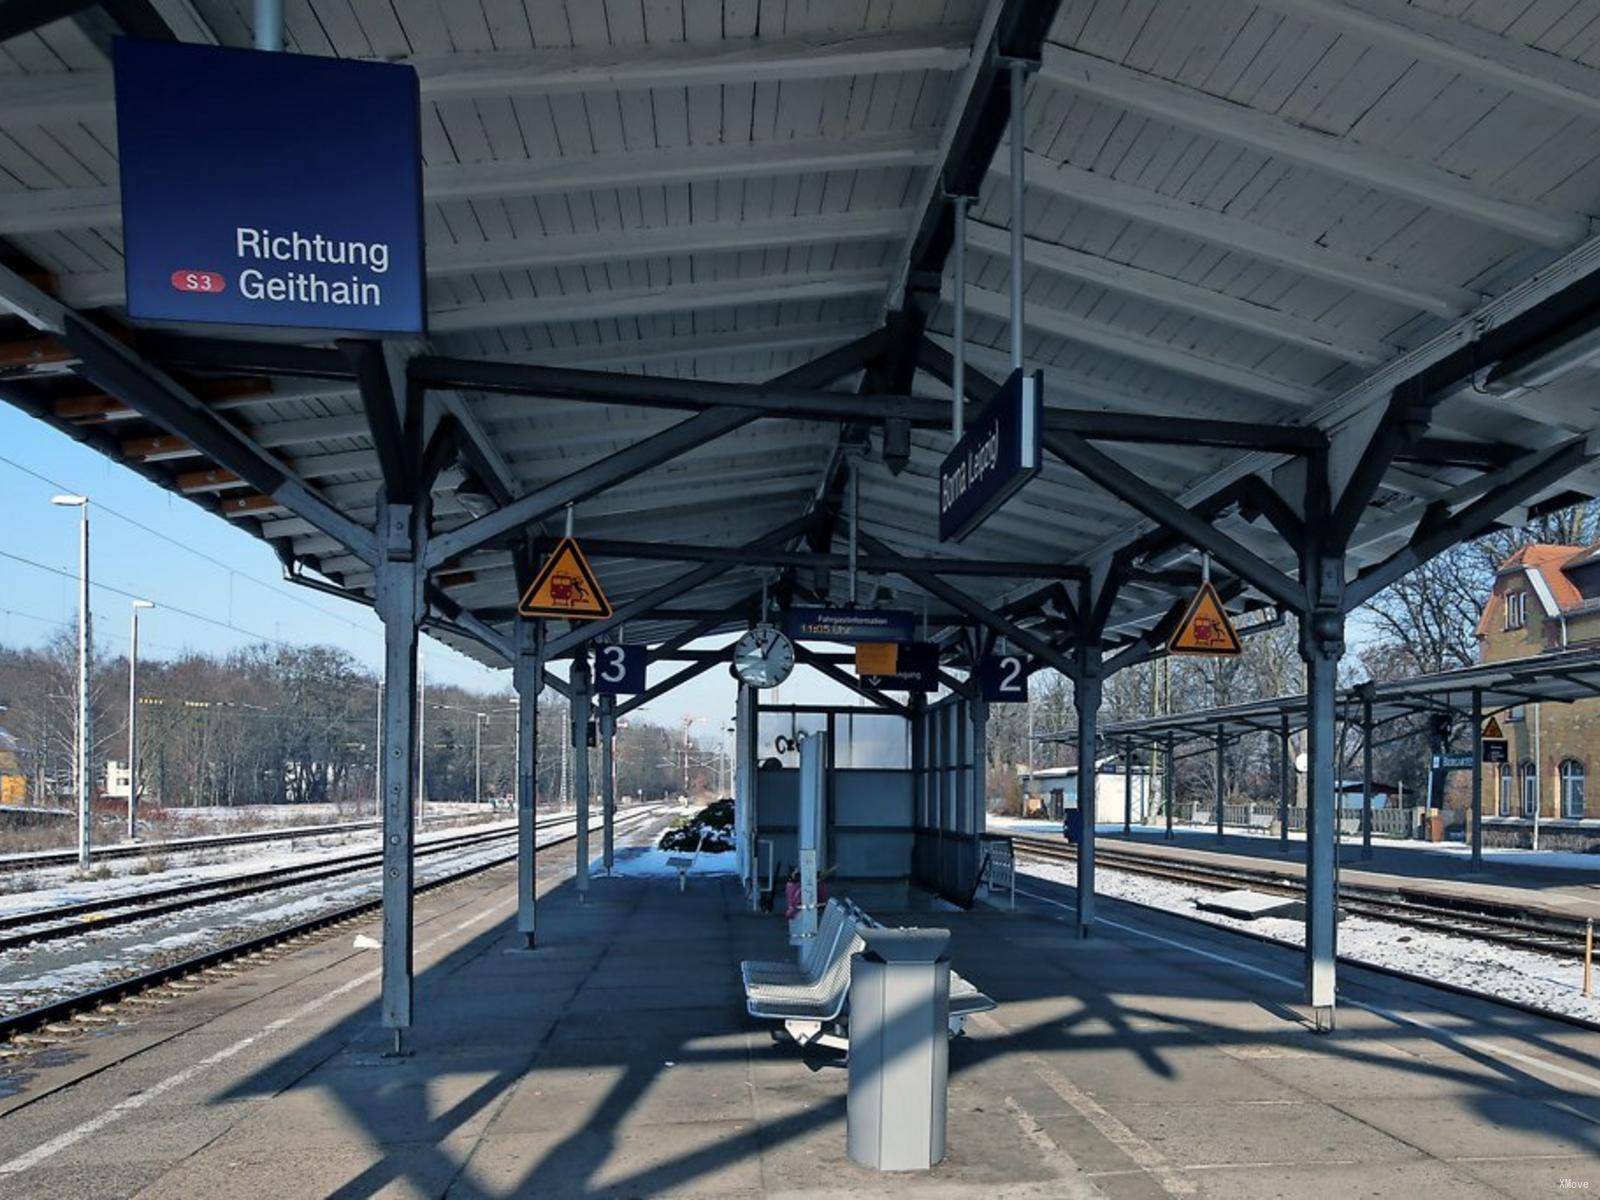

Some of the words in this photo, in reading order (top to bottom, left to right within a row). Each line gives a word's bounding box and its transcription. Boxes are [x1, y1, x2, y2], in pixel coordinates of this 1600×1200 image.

[236, 227, 389, 273] Richtung
[186, 275, 213, 291] S3
[238, 269, 381, 306] Geithain
[600, 646, 626, 683] 3
[999, 657, 1021, 691] 2
